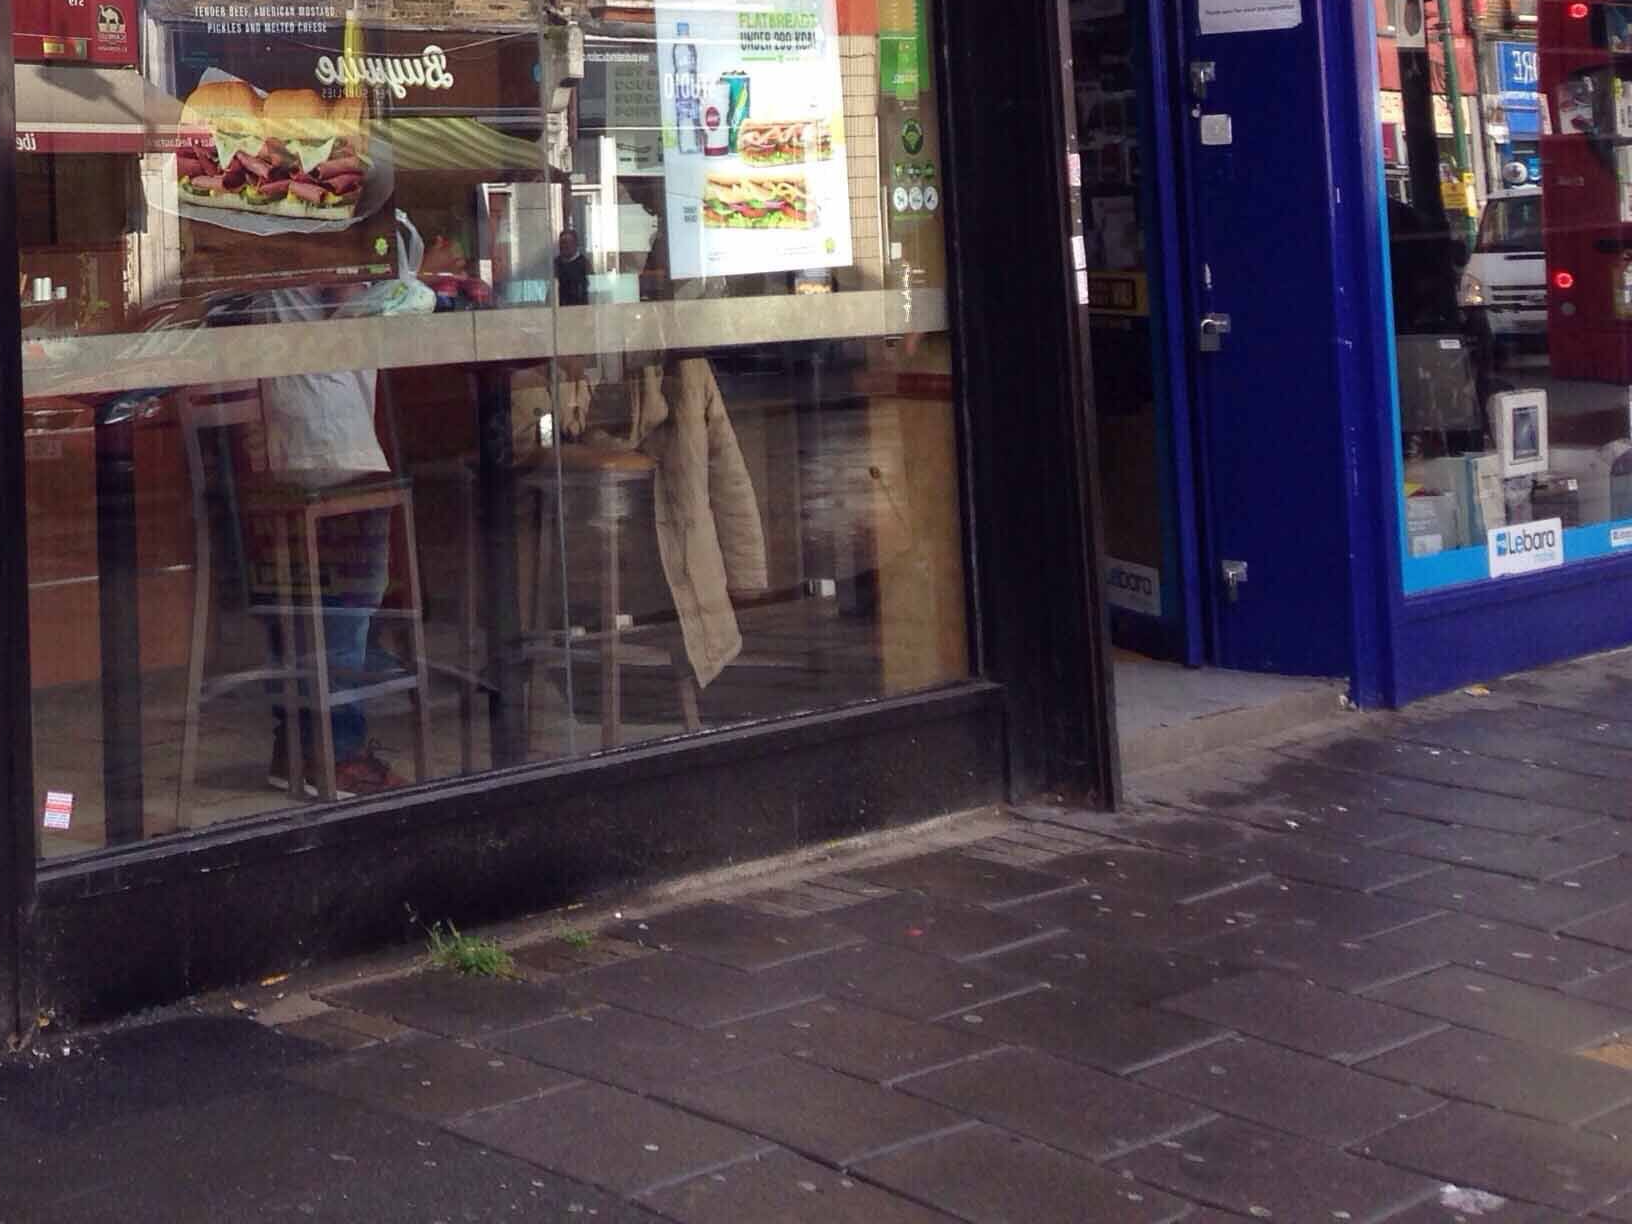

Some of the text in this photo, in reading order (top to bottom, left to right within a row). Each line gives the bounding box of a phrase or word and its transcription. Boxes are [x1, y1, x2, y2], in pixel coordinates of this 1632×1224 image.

[207, 22, 243, 34] PICKLES
[245, 22, 262, 33] AND
[264, 22, 296, 33] MELTED
[1508, 528, 1556, 555] Lebara
